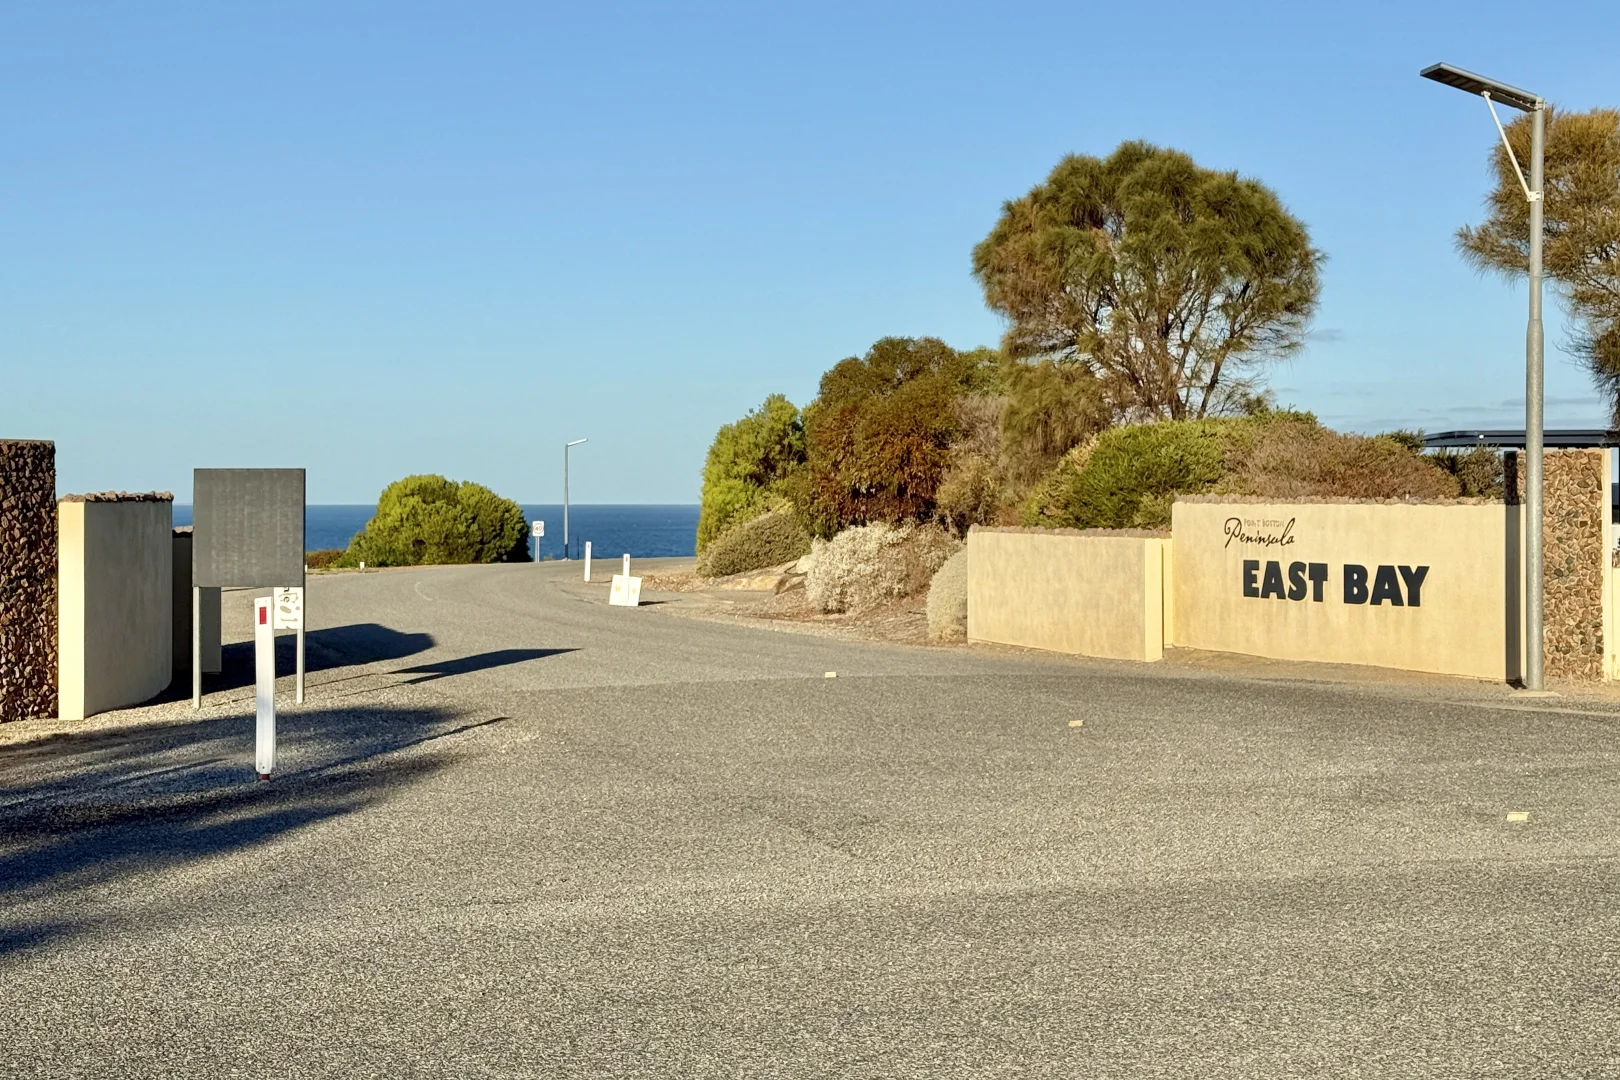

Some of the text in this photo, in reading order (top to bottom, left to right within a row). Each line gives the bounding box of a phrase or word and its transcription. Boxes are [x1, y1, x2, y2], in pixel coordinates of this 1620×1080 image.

[1224, 517, 1295, 549] Peninsula
[1243, 559, 1430, 607] EAST BAY
